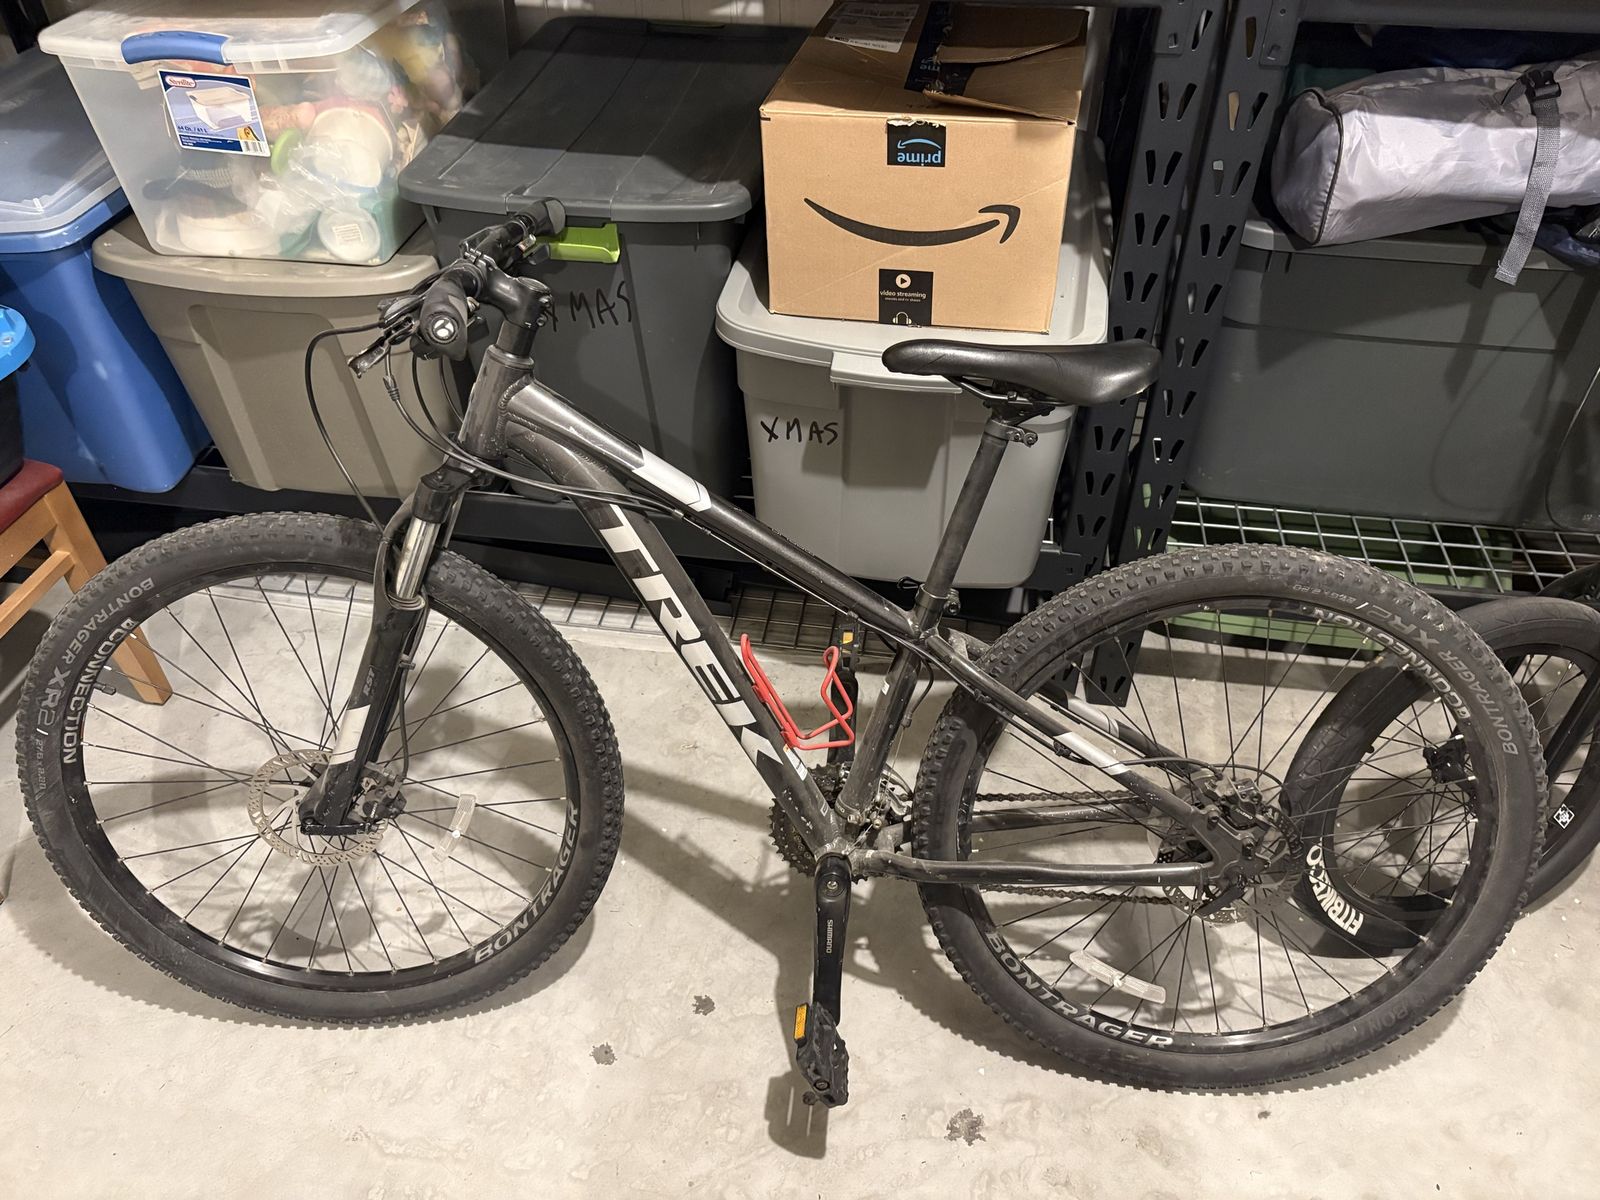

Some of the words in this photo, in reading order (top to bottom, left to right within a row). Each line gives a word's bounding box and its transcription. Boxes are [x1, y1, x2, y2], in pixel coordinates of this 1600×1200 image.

[897, 151, 942, 167] prime
[896, 291, 927, 300] streaming
[760, 416, 839, 446] XMAS
[61, 577, 156, 666] BONTRAGER
[599, 503, 784, 768] TREK
[1312, 606, 1464, 709] CONNECTION
[1366, 604, 1441, 650] XR2
[37, 665, 72, 726] XR2
[63, 627, 129, 764] CONNECTION
[362, 667, 376, 697] RST
[1437, 650, 1519, 756] BONTRAGER
[474, 800, 580, 964] BONTRAGER
[825, 918, 834, 955] SHIMANO
[984, 930, 1175, 1049] BONTRAGER
